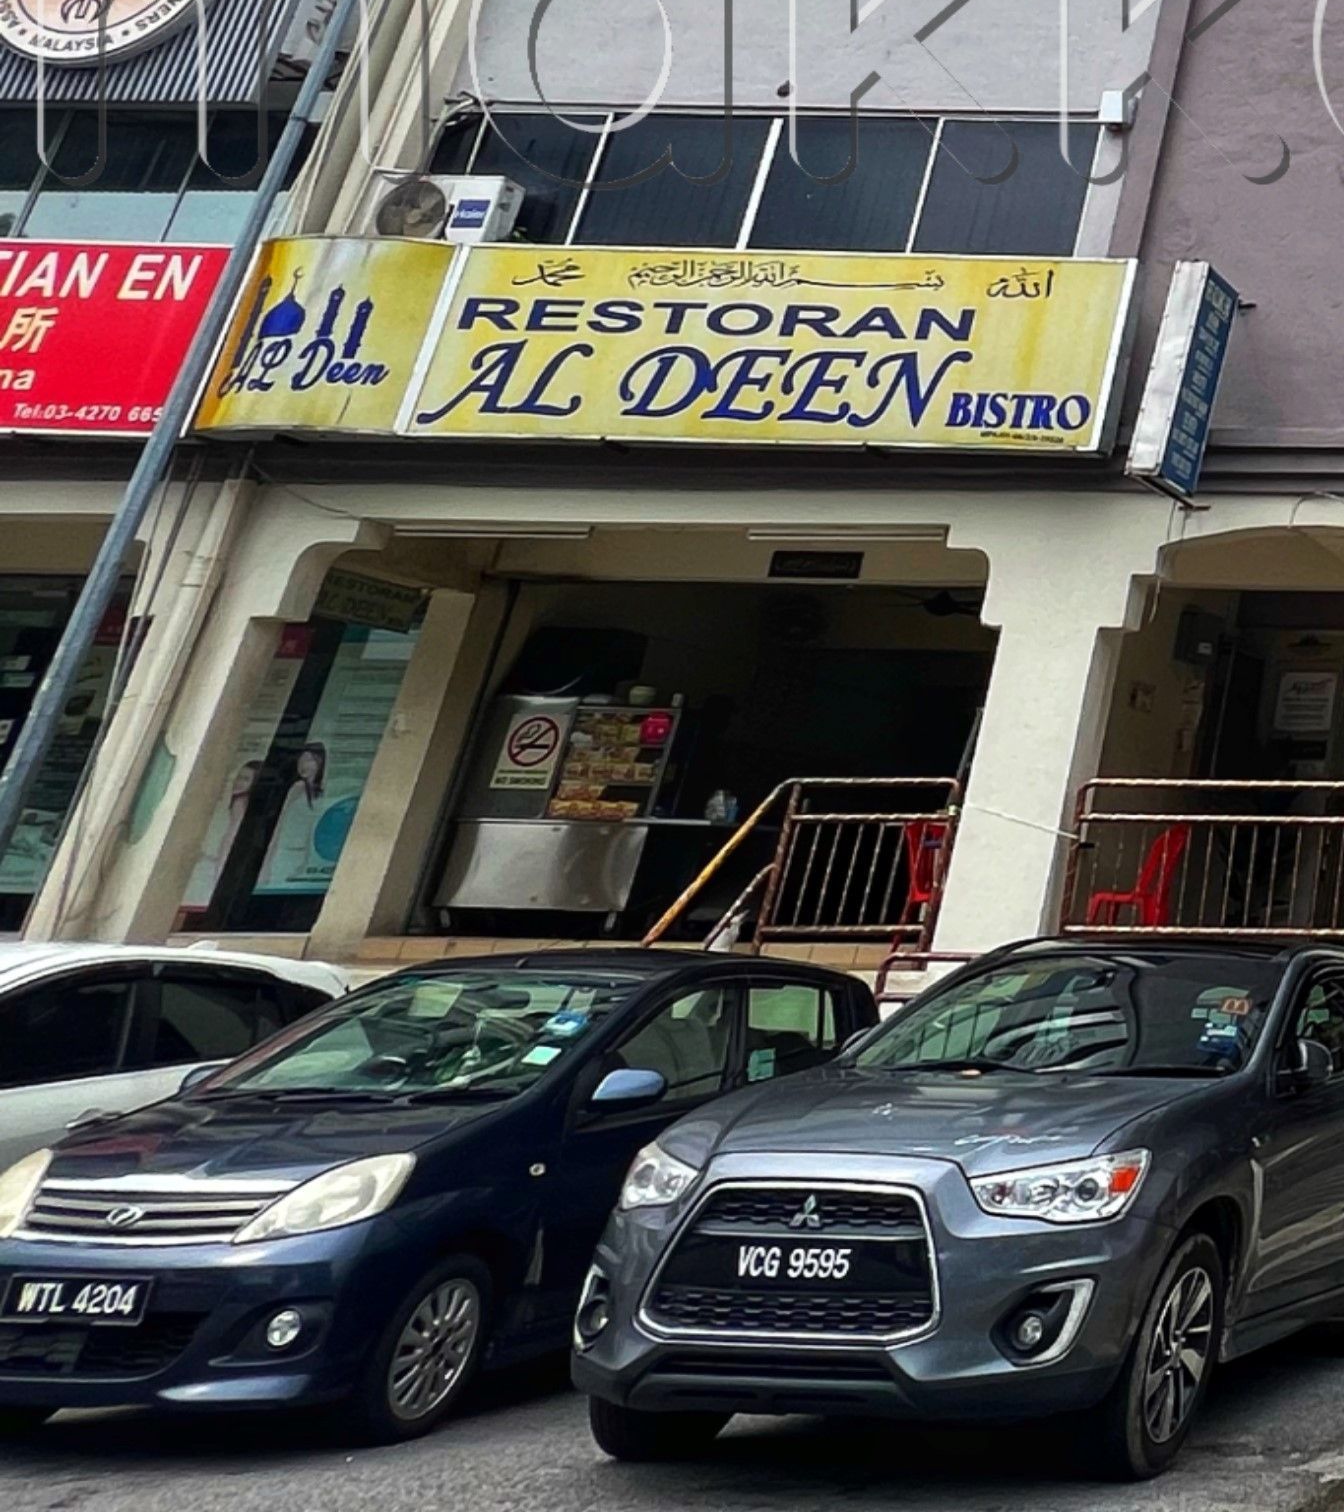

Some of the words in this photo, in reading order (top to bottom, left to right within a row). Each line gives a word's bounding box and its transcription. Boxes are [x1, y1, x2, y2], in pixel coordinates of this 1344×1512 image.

[117, 253, 203, 301] EN
[457, 297, 976, 341] RESTORAN
[290, 338, 390, 392] Deen
[416, 339, 595, 425] AL
[619, 345, 973, 429] DEEN
[945, 392, 1091, 431] BISTRO
[127, 405, 166, 423] 665
[738, 1245, 782, 1277] VCG
[787, 1248, 852, 1279] 9595
[17, 1282, 66, 1313] WTL
[71, 1283, 140, 1315] 4204
